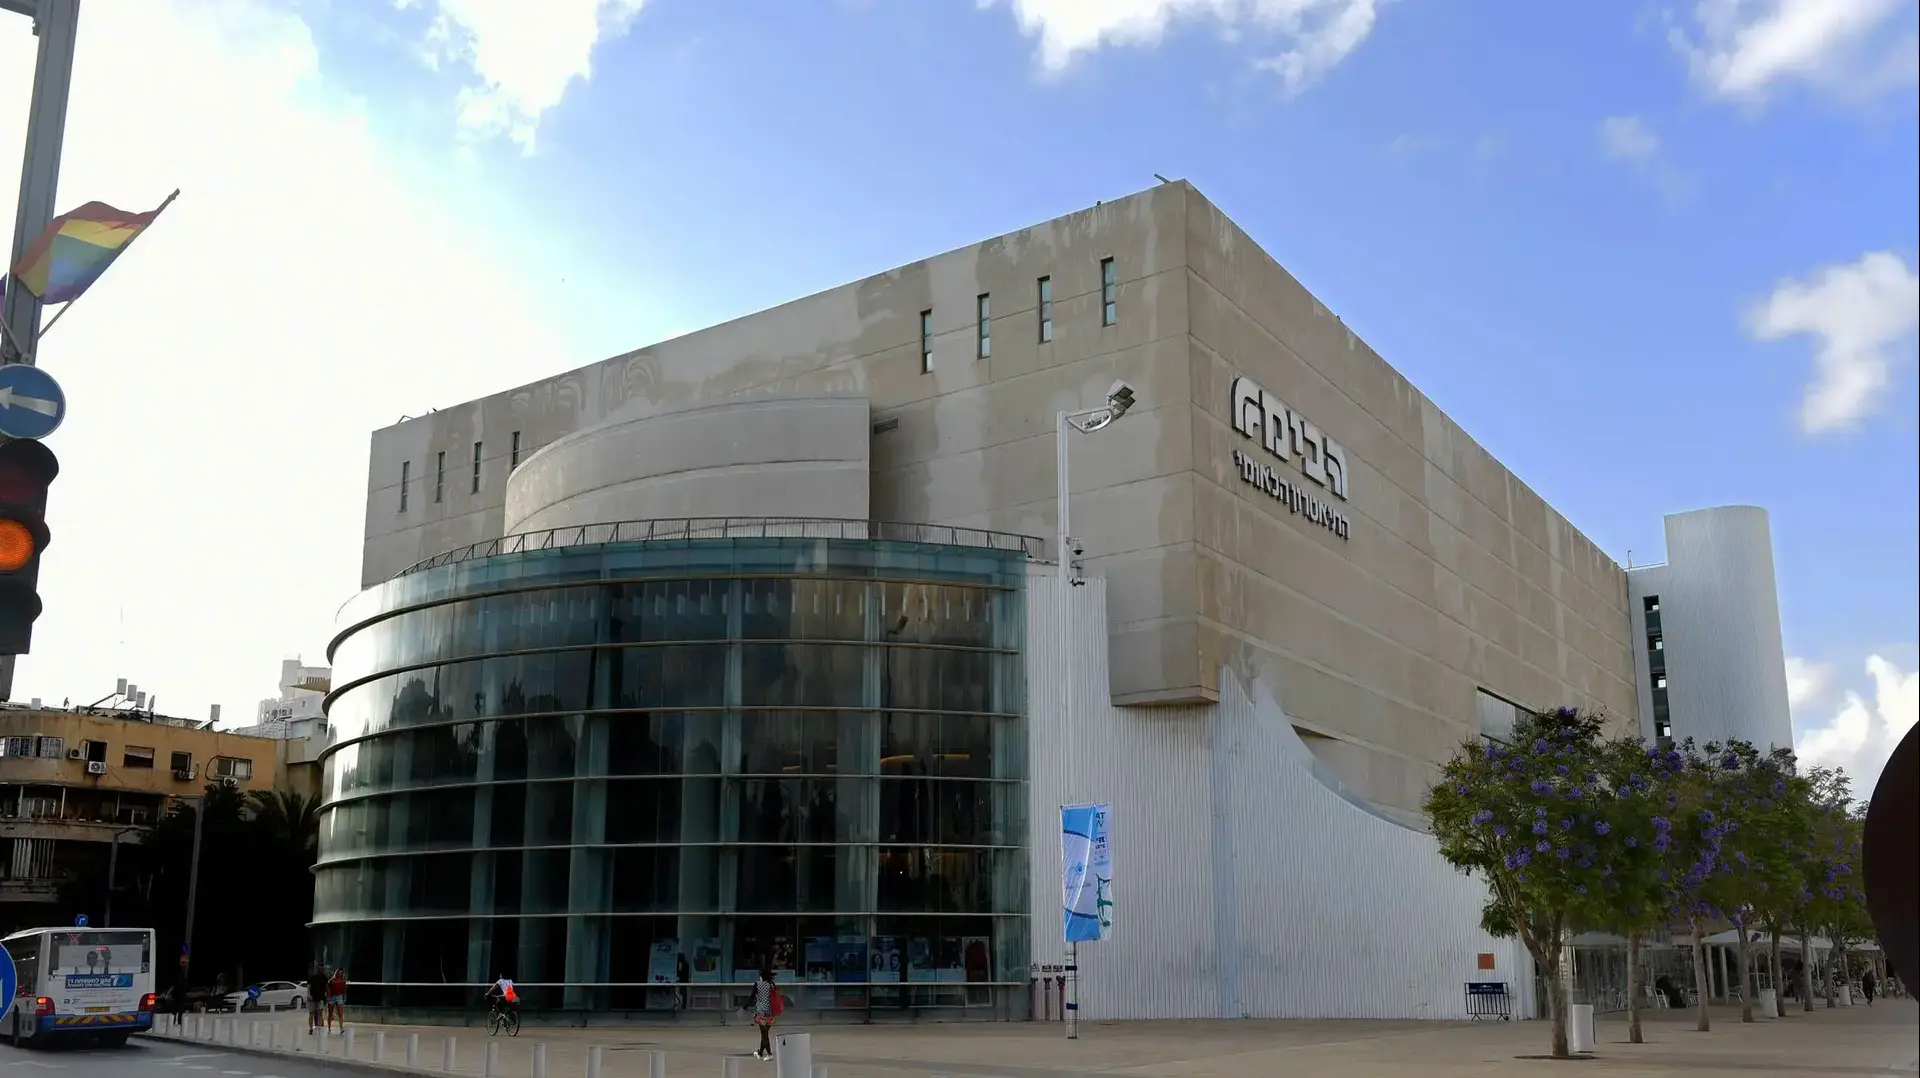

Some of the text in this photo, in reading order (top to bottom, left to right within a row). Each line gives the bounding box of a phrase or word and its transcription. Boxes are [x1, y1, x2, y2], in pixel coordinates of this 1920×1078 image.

[1231, 376, 1348, 501] הבימה
[1233, 449, 1349, 540] התיאטרון הלאומי
